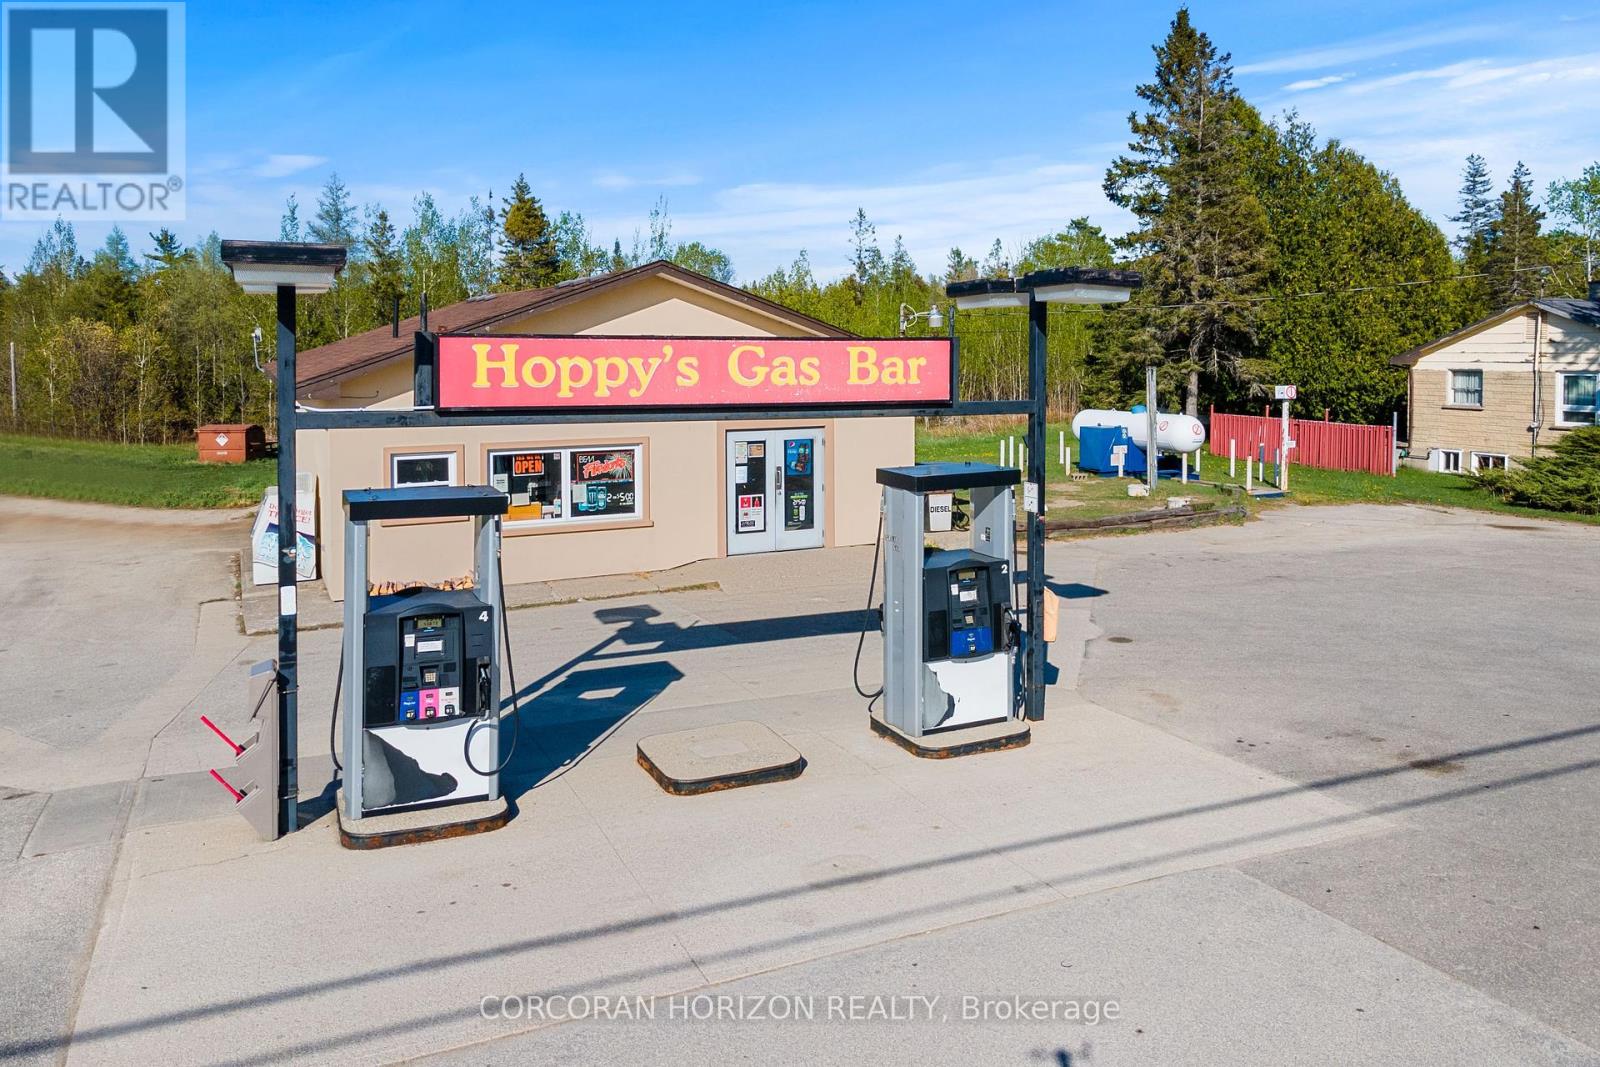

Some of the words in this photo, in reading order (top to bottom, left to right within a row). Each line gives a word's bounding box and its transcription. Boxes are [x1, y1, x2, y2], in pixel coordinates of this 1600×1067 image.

[471, 343, 699, 398] Hoppy's
[727, 345, 821, 387] Gas
[846, 346, 927, 386] Bar
[515, 460, 542, 473] OPEN
[930, 505, 952, 513] DIESEL
[1001, 564, 1008, 574] 2
[478, 610, 489, 622] 4
